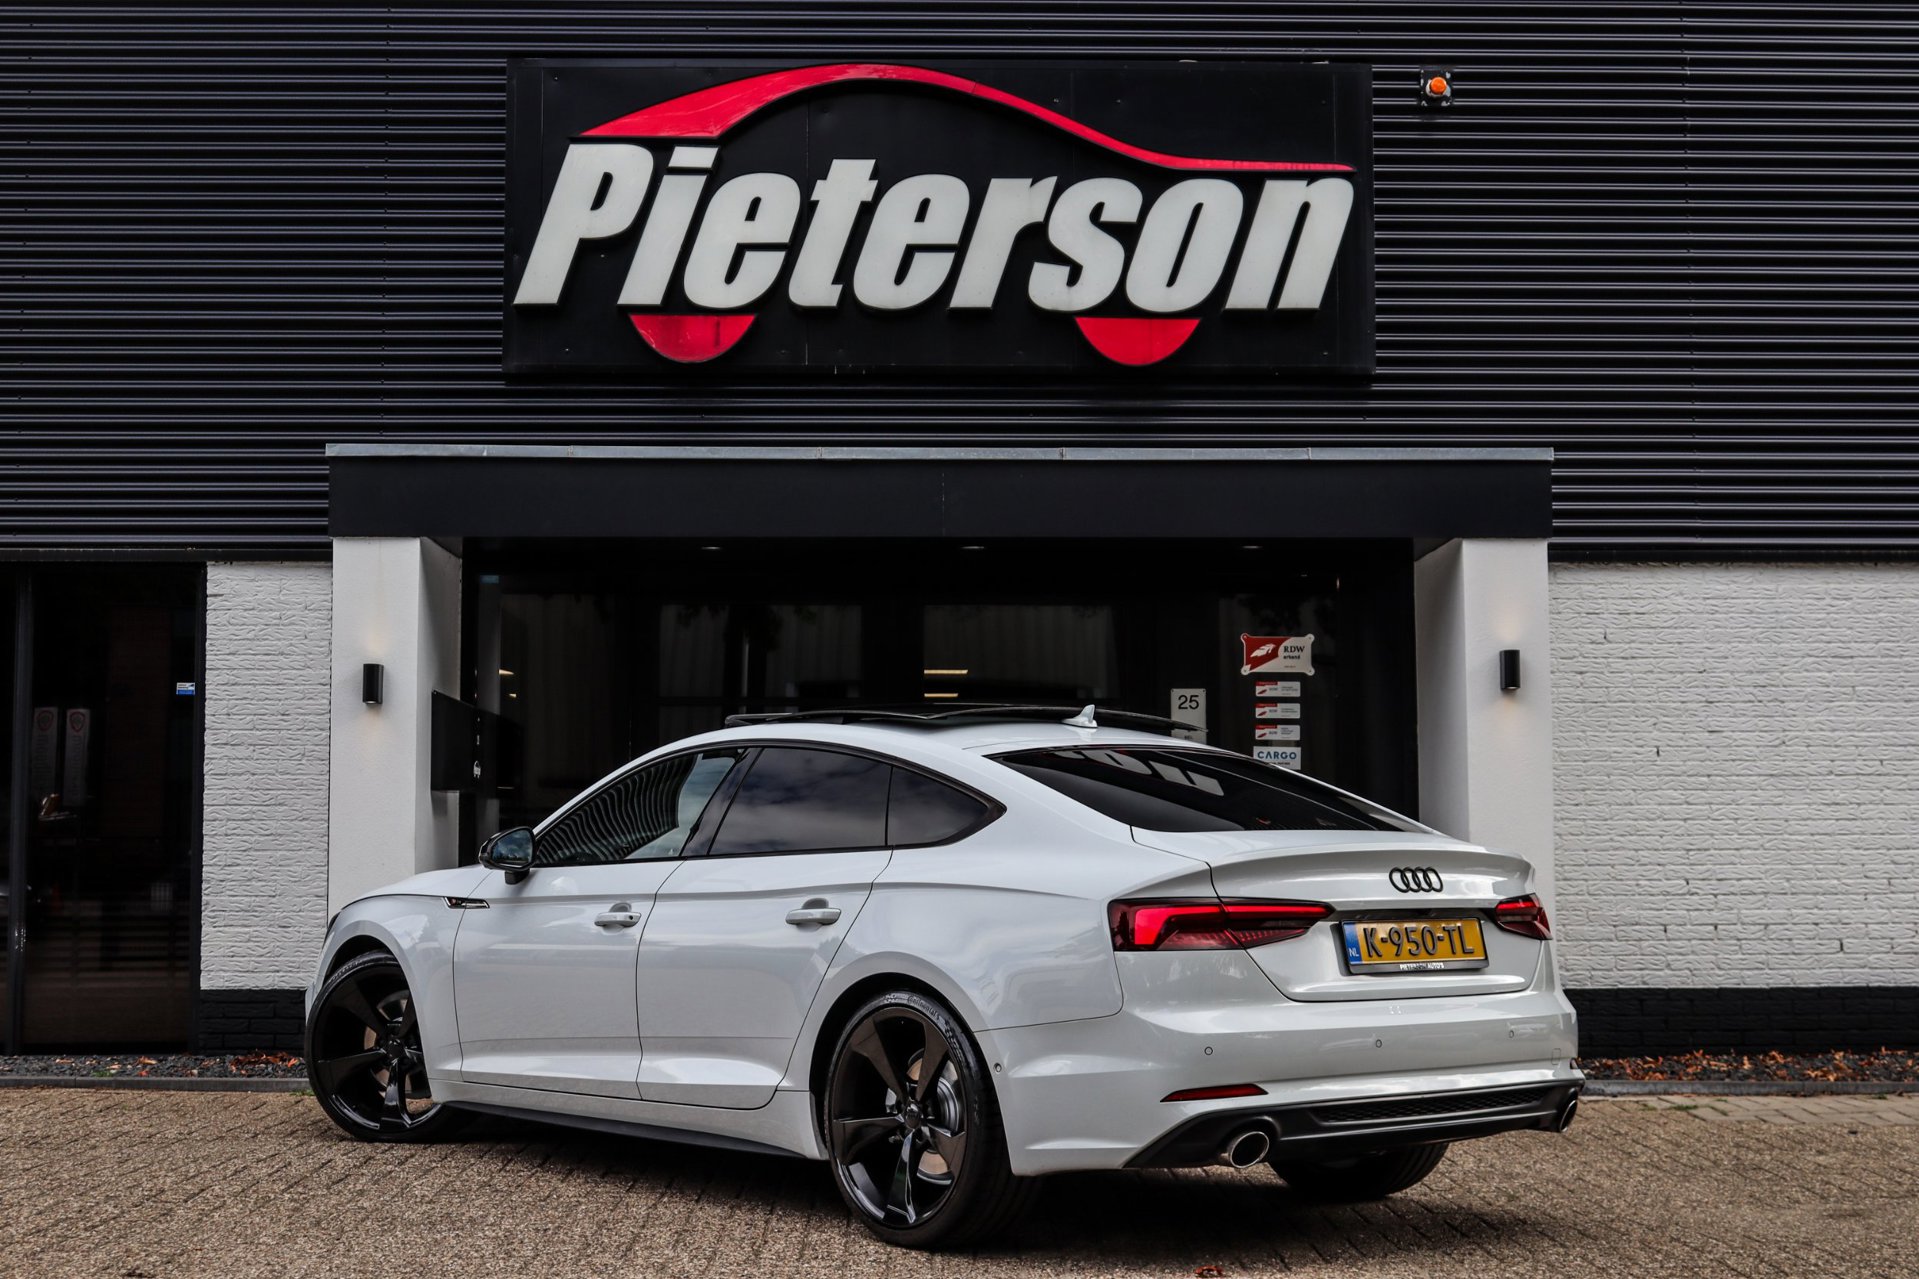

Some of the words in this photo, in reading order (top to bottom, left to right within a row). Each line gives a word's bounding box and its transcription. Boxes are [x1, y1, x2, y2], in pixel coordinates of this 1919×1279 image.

[513, 143, 1355, 313] Pieterson
[1283, 645, 1305, 653] RDW
[1178, 694, 1199, 710] 25
[1257, 751, 1297, 760] CARGO
[1363, 923, 1475, 958] K-950-TL
[1348, 948, 1360, 958] NL
